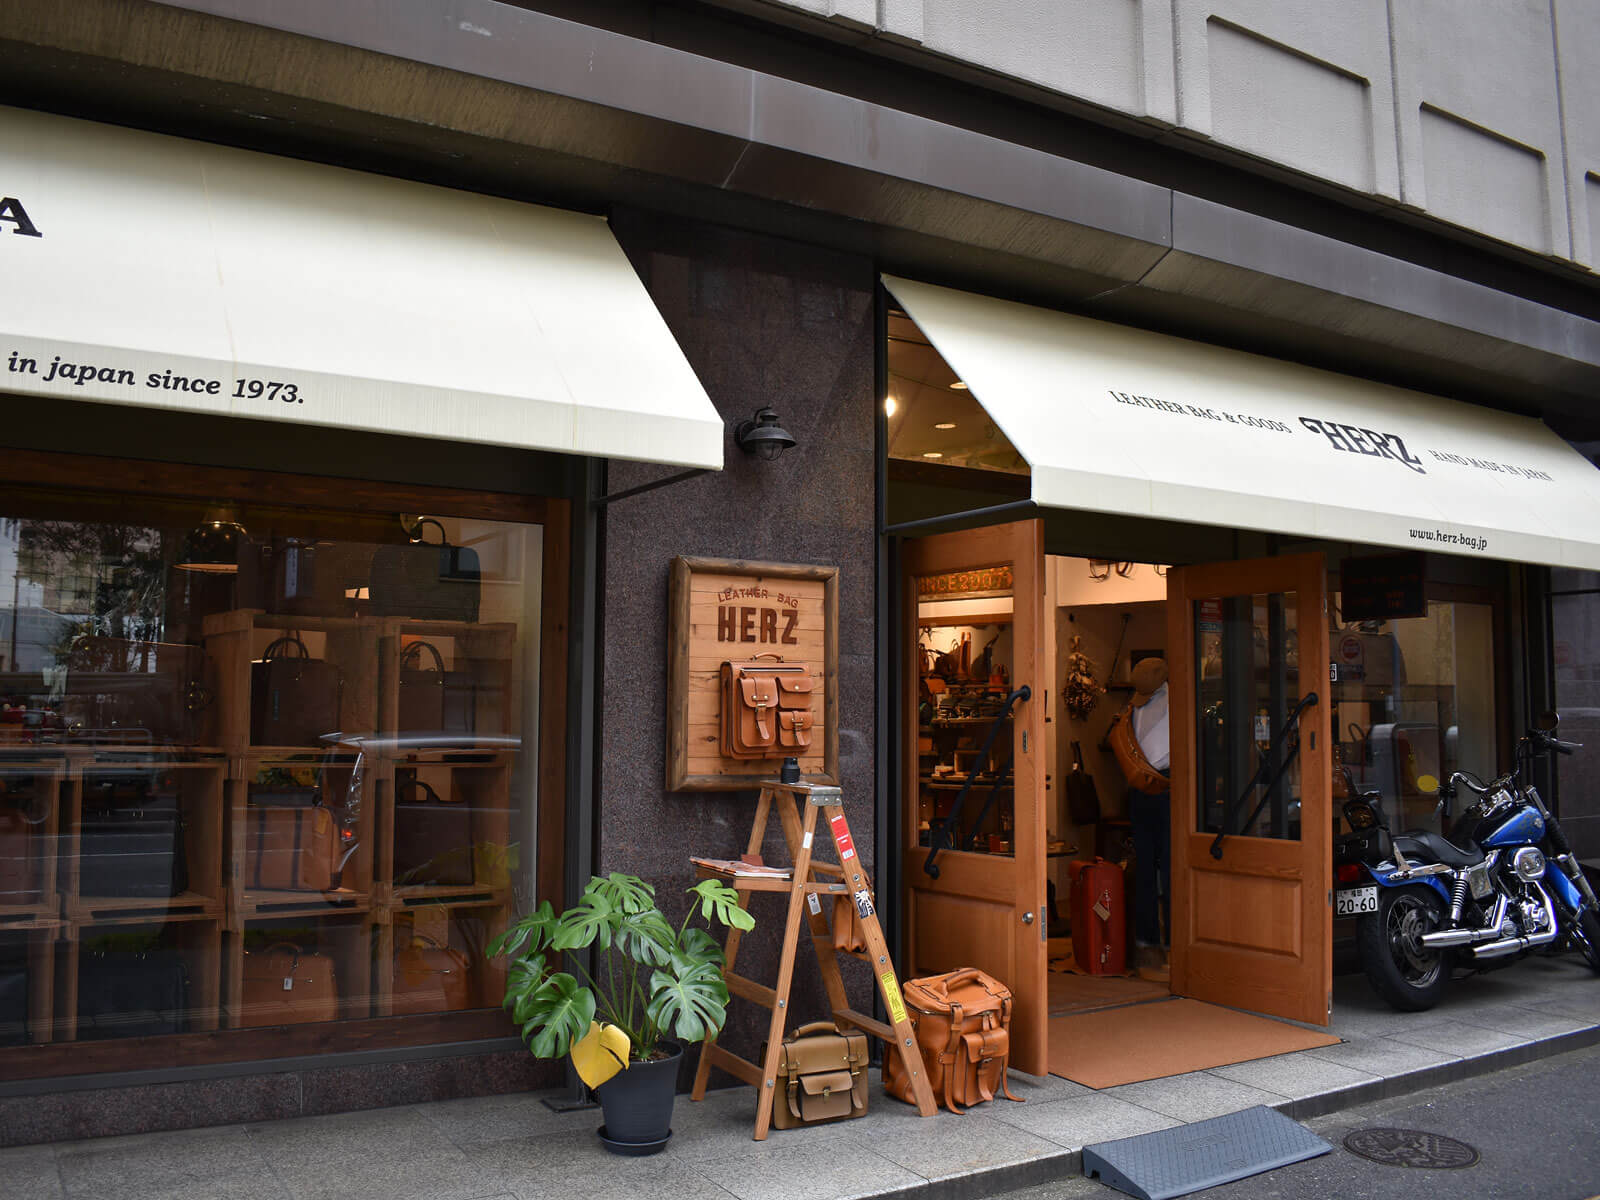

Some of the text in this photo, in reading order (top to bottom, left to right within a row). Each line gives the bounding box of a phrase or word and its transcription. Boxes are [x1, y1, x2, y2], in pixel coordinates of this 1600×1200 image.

[8, 351, 304, 404] in japan since 1973.
[1108, 390, 1292, 434] LEATHER BAG & GOODS
[1298, 416, 1427, 474] HERZ
[1428, 450, 1555, 481] HAND MADE IN JAPAN
[1409, 528, 1487, 550] www.herz-bag.jp
[718, 587, 799, 609] LEATHER BAG
[717, 605, 799, 645] HERZ
